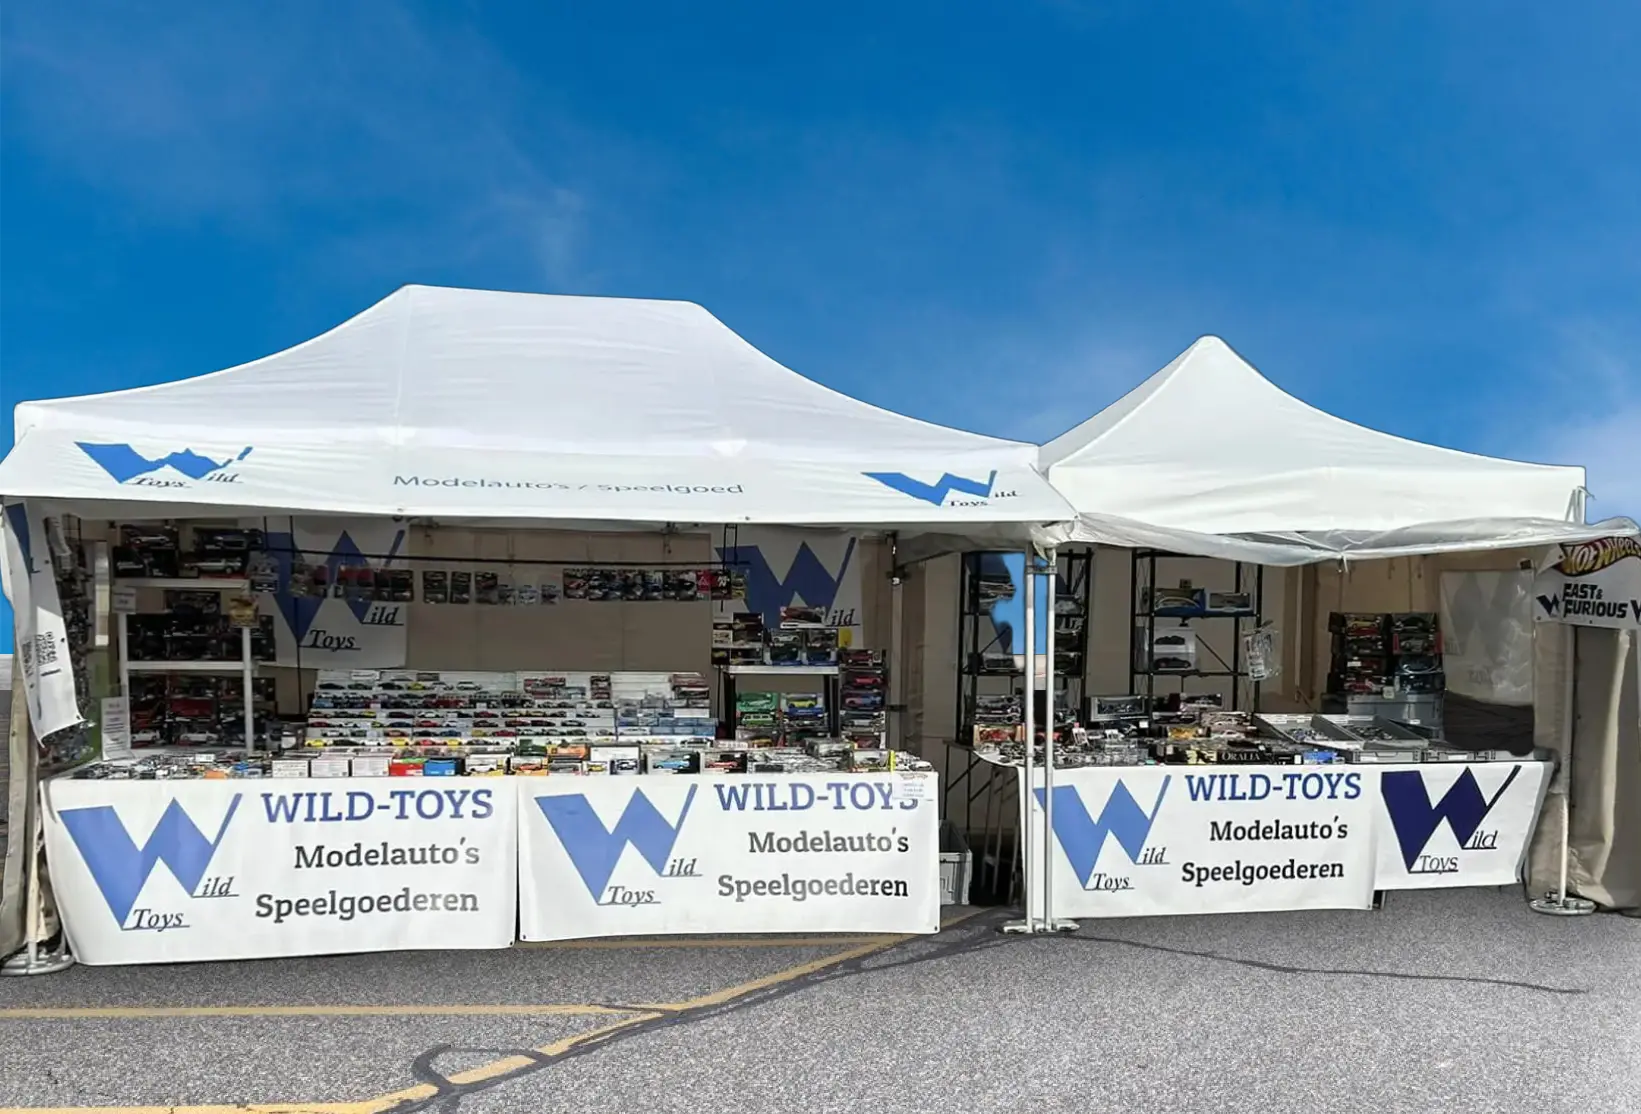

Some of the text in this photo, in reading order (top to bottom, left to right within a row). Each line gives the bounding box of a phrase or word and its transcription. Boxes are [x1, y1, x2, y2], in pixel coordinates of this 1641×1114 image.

[393, 475, 571, 490] Modelauto's
[1563, 599, 1629, 619] FURIOUS
[309, 629, 356, 652] Toys
[1184, 772, 1362, 802] WILD-TOYS
[260, 789, 494, 823] WILD-TOYS
[748, 828, 908, 854] Modelauto's
[1209, 815, 1348, 842] Modelauto's
[294, 837, 480, 869] Modelauto's
[1419, 854, 1459, 875] Toys
[1093, 873, 1130, 893] Toys
[1181, 861, 1345, 888] Speelgoederen
[608, 886, 655, 908] Toys
[718, 875, 908, 902] Speelgoederen
[255, 887, 479, 923] Speelgoederen
[133, 909, 185, 933] Toys
